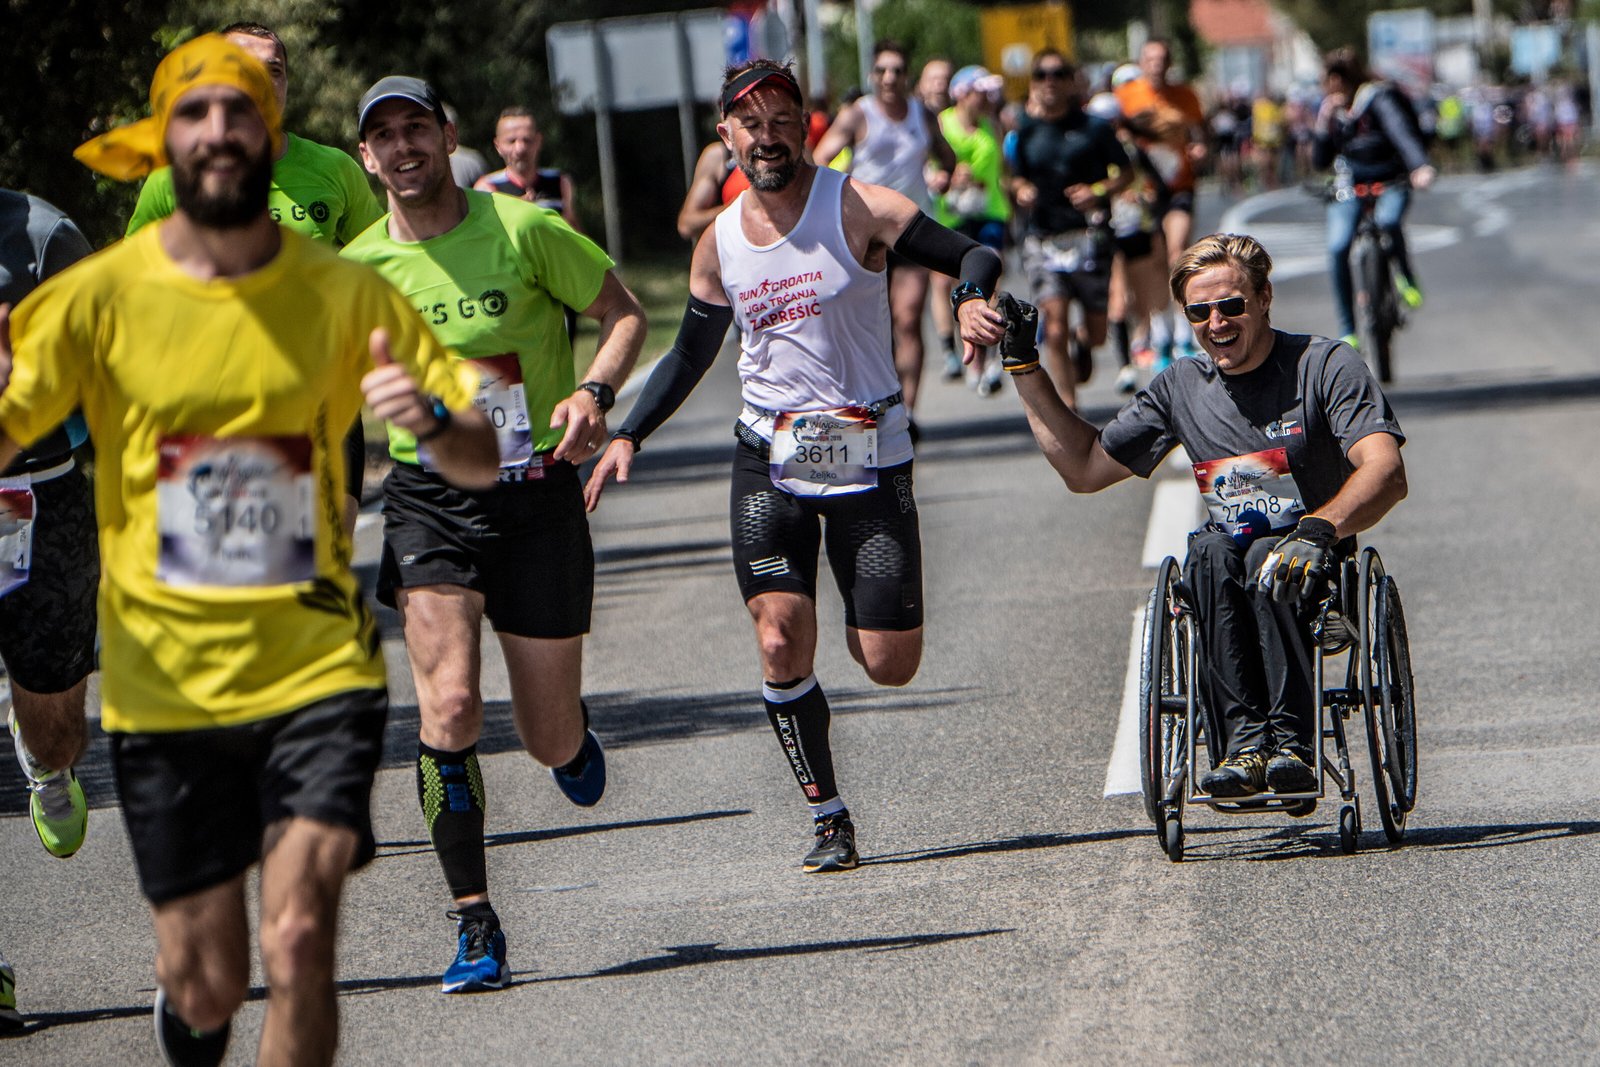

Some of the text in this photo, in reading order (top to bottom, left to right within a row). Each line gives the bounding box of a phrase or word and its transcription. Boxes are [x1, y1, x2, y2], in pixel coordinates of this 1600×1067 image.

[738, 271, 823, 303] RUN CROATIA
[744, 288, 817, 317] LIGA TRČANJA
[750, 299, 822, 332] ZAPREŠIĆ
[516, 414, 526, 426] 2
[795, 444, 848, 464] 3611
[866, 453, 873, 465] 1
[810, 469, 837, 480] Željko
[1227, 473, 1256, 483] WINGS
[1233, 481, 1250, 489] LIFE
[1291, 499, 1300, 509] 4
[194, 503, 279, 535] 5140
[17, 553, 24, 568] 1
